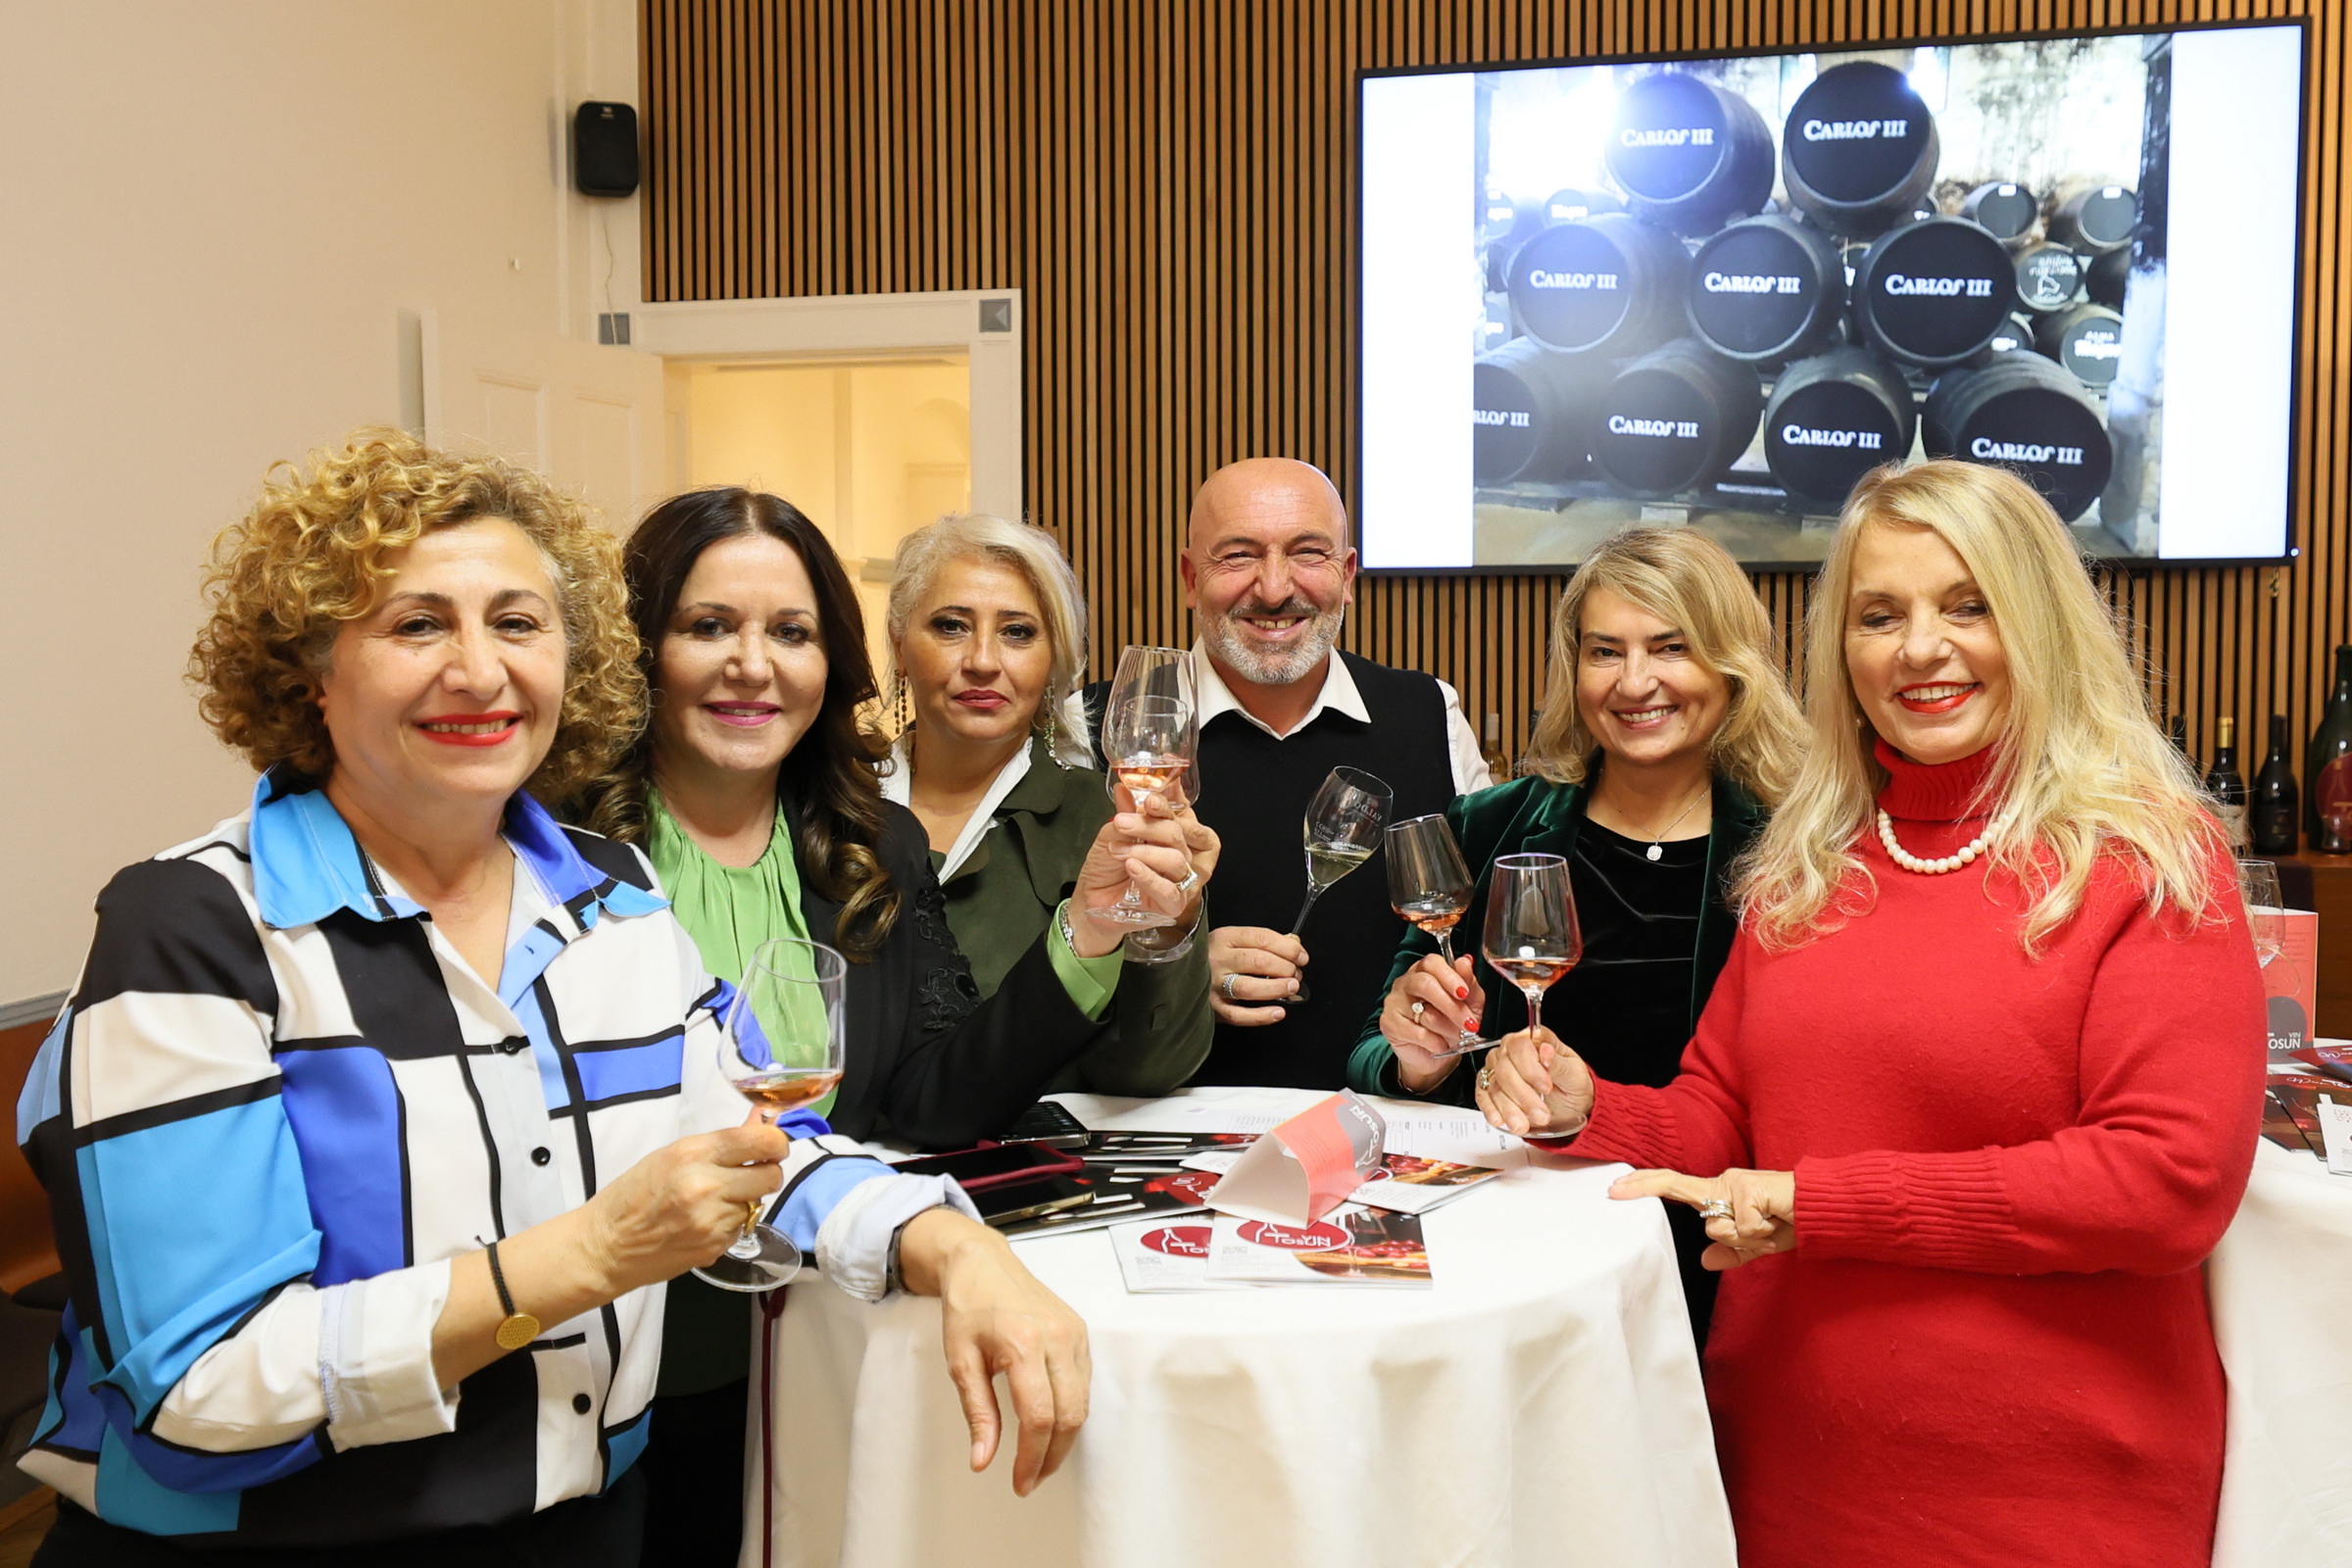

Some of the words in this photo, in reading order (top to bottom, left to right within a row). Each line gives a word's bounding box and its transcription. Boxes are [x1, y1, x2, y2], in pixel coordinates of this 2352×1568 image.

[1620, 128, 1689, 146] CARLOS
[1690, 128, 1714, 145] III
[1803, 120, 1881, 141] CARLOS
[1883, 120, 1907, 137] III
[1530, 270, 1594, 289] CARLOS
[1596, 273, 1618, 290] III
[1704, 272, 1775, 293] CARLOS
[1777, 277, 1800, 294] III
[1885, 274, 1965, 296] CARLOS
[1967, 279, 1992, 296] III
[1510, 412, 1530, 427] III
[1609, 416, 1676, 437] CARLOS
[1677, 421, 1698, 438] III
[1783, 424, 1856, 448] CARLOS
[1858, 431, 1882, 449] III
[1971, 437, 2055, 464] CARLOS
[2057, 447, 2083, 465] III
